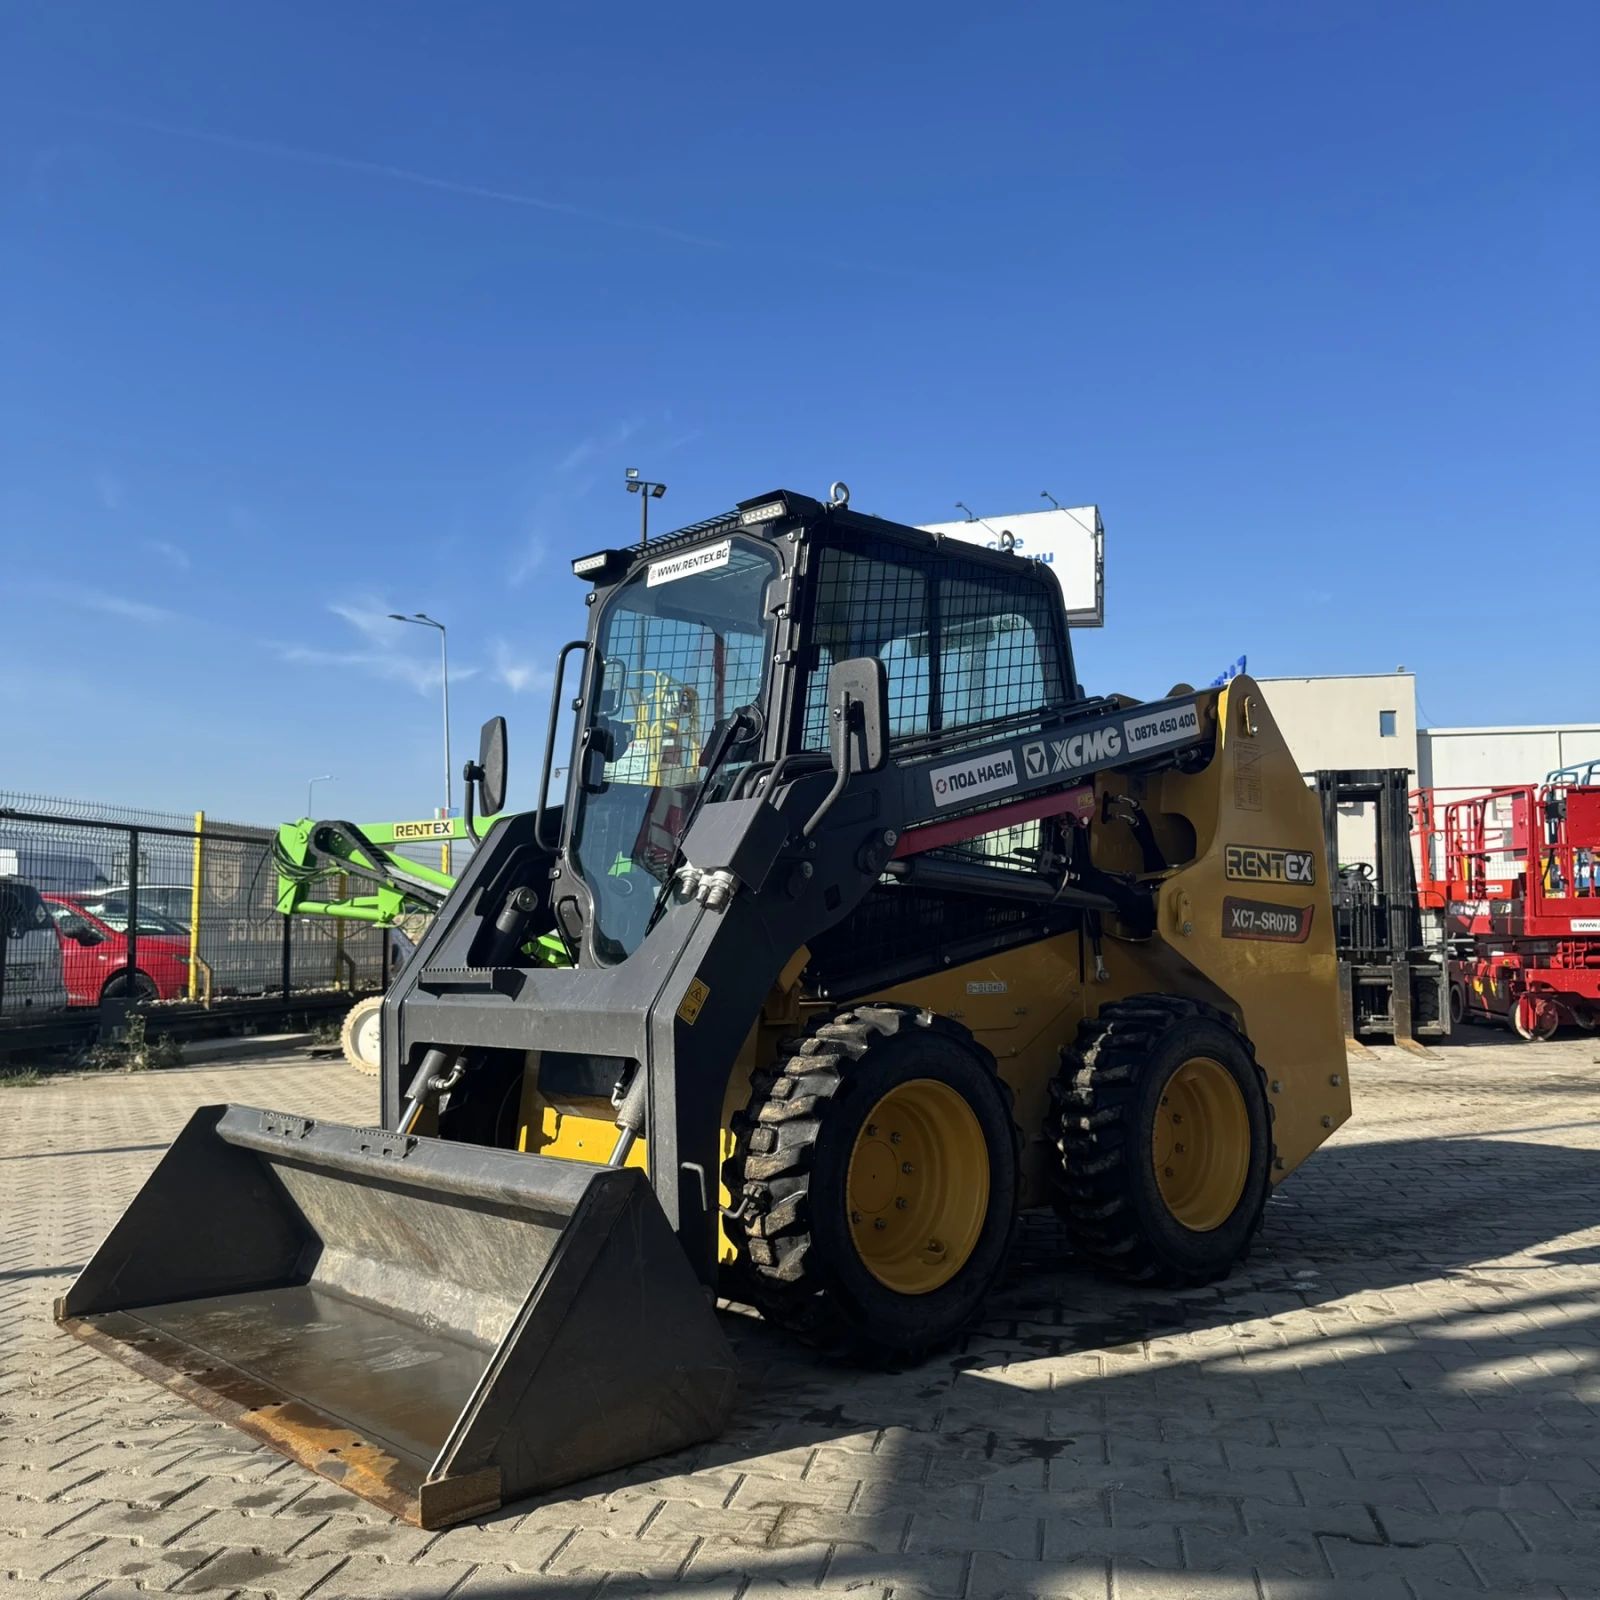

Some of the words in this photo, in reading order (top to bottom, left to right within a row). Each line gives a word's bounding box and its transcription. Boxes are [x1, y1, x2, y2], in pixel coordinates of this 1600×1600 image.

[657, 548, 728, 577] WWW.RENTEX.BG
[1135, 722, 1158, 741] 0878
[1159, 717, 1178, 735] 450
[1178, 712, 1197, 729] 400
[1050, 727, 1122, 774] XCMG
[948, 774, 978, 792] ПОД
[977, 760, 1014, 783] НАЕМ
[395, 821, 451, 837] RENTEX
[1228, 850, 1312, 881] RENTEX
[1231, 908, 1297, 932] XC7-SR07B
